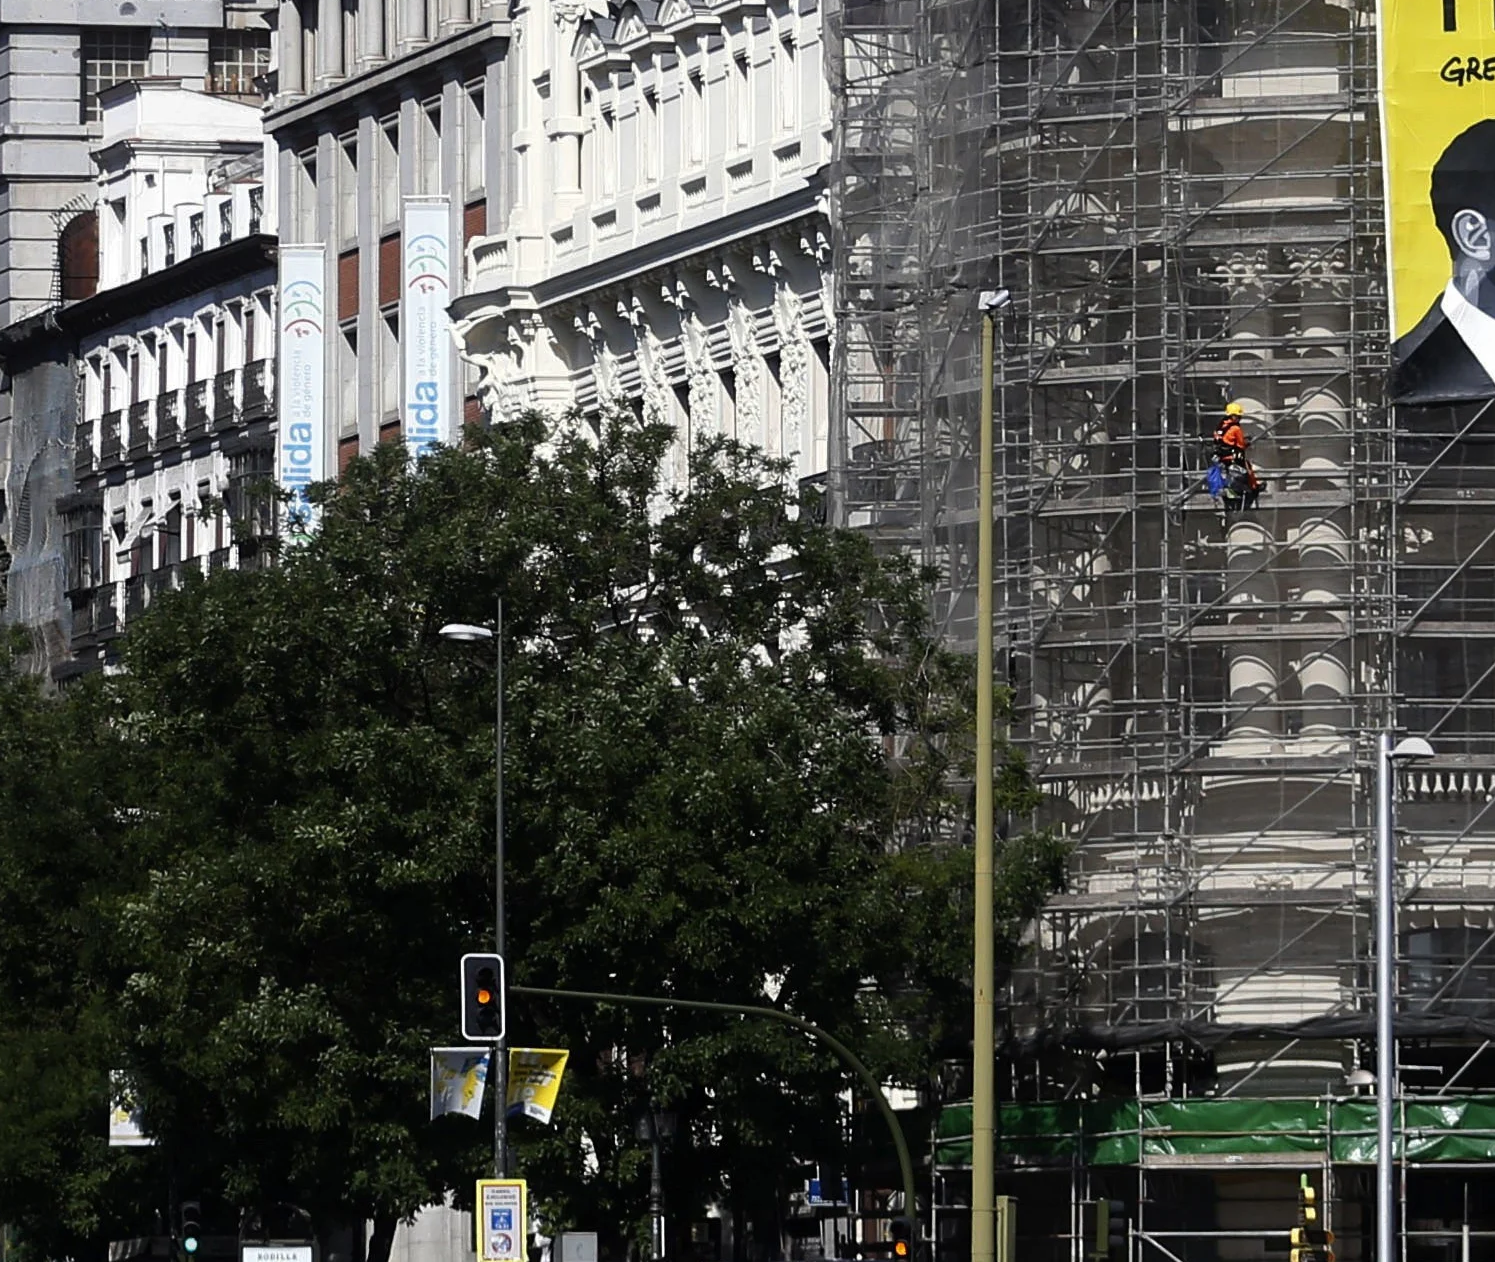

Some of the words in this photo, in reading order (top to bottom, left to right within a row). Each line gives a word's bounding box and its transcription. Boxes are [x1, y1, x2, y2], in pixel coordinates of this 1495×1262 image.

[415, 305, 426, 356] violencia
[291, 349, 302, 396] violencia
[407, 381, 439, 461] alida
